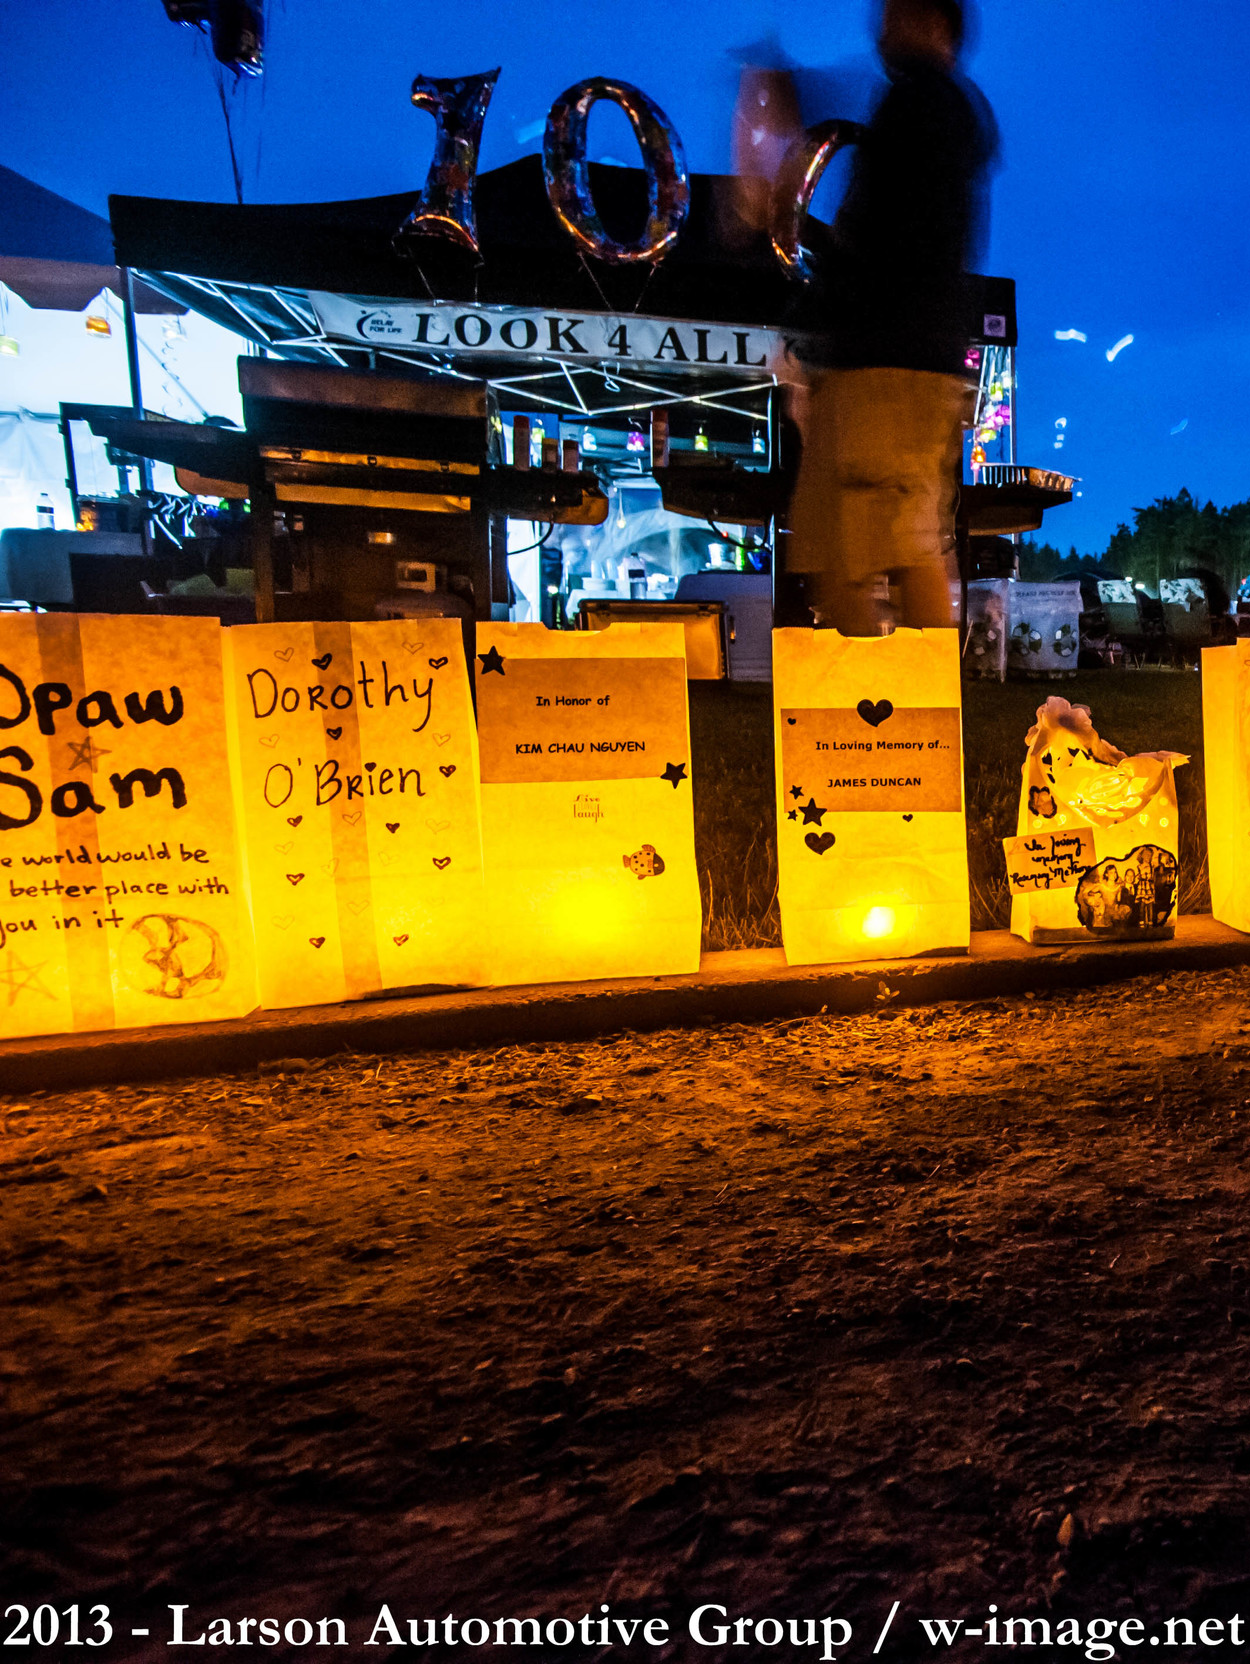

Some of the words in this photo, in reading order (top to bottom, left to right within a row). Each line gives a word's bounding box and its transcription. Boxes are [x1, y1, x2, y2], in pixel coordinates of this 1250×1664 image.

[412, 311, 589, 354] LOOK
[607, 324, 632, 357] 4
[654, 326, 768, 367] ALL
[536, 696, 550, 706] In
[555, 696, 591, 706] Honor
[597, 695, 610, 706] of
[515, 743, 543, 754] KIM
[548, 743, 584, 753] CHAU
[590, 741, 645, 753] NGUYEN
[816, 741, 829, 750] In
[833, 741, 873, 752] Loving
[876, 741, 924, 751] Memory
[827, 779, 867, 788] JAMES
[871, 778, 921, 787] DUNCAN
[22, 845, 92, 866] world
[96, 842, 171, 864] would
[180, 843, 210, 864] be
[10, 879, 97, 897] better
[105, 880, 168, 904] place
[178, 876, 229, 895] with
[52, 915, 81, 929] in
[93, 908, 124, 928] it
